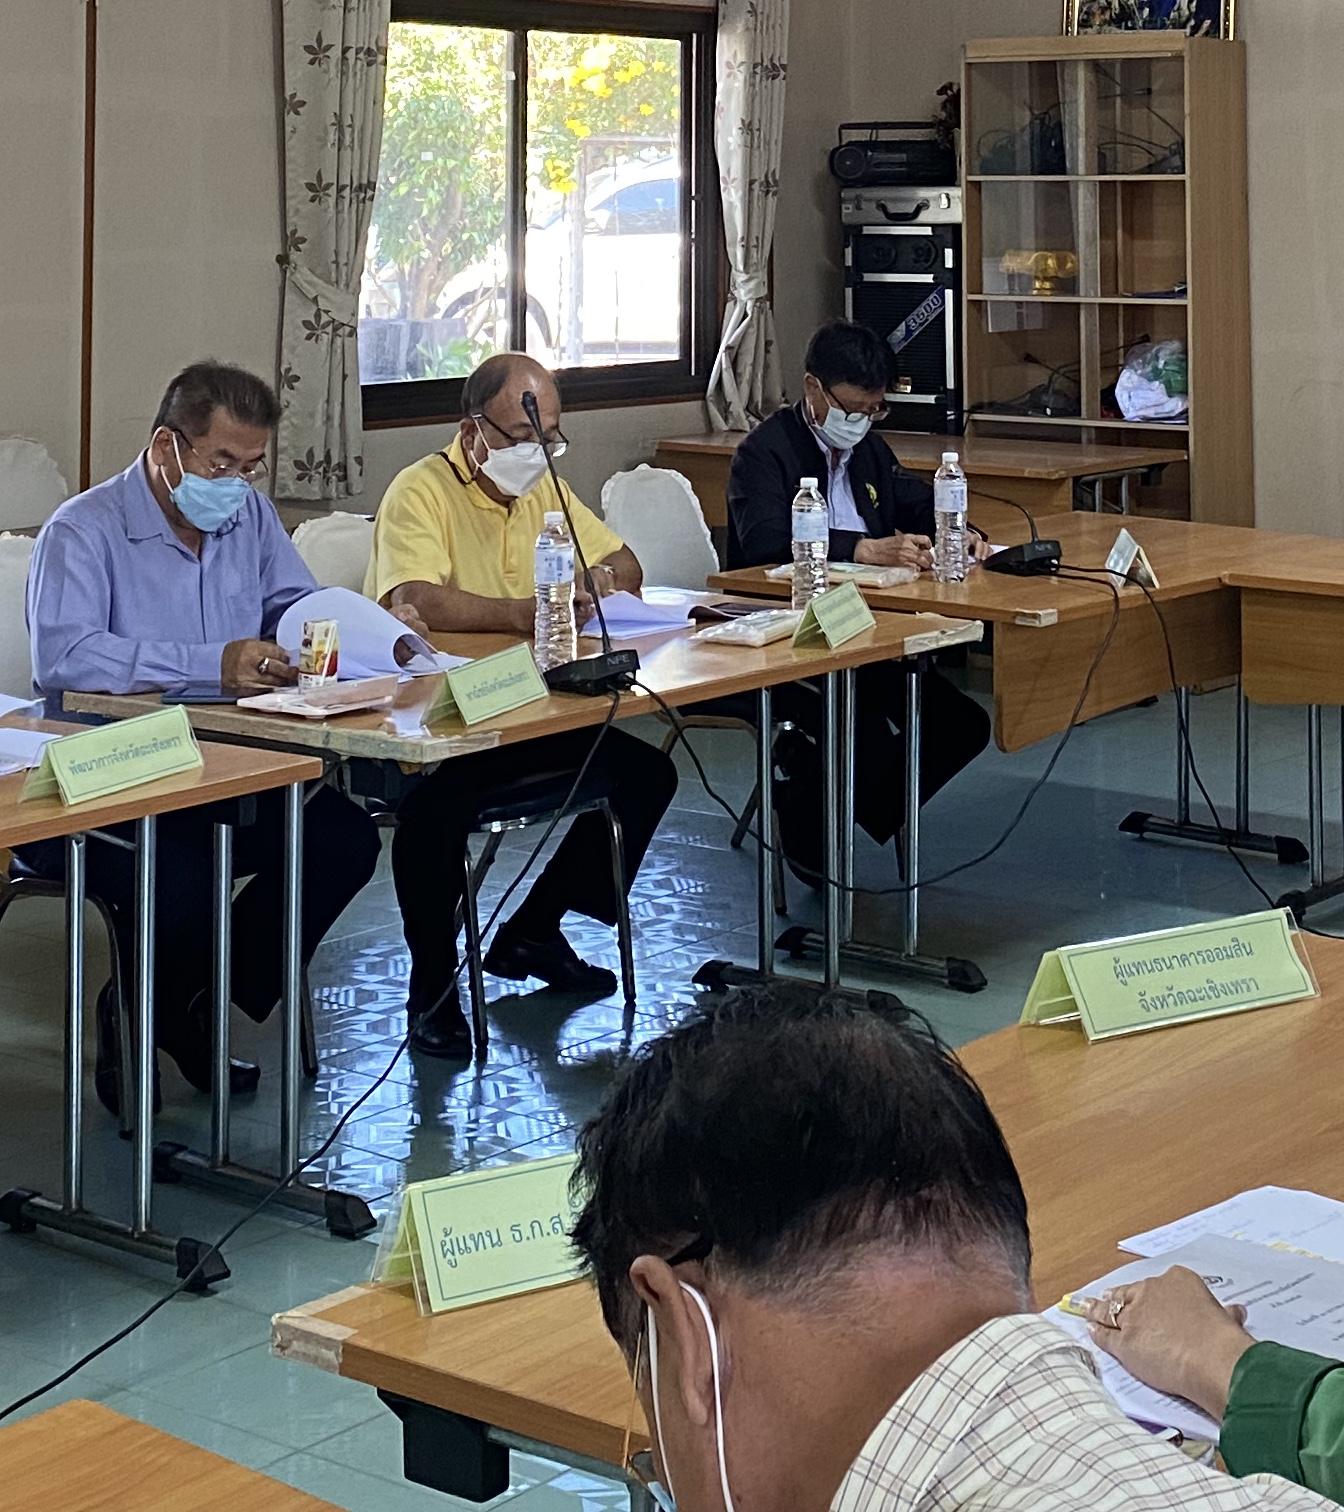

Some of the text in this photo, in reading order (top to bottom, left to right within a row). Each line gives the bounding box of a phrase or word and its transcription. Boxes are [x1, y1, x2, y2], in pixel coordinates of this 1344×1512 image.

[907, 294, 942, 330] 3500
[607, 654, 630, 666] NPE
[1113, 936, 1255, 987] ผู้แทนธนาคารออมสิน
[1138, 975, 1260, 1014] จังหวัดฉะเชิงเทรา
[439, 1226, 503, 1269] ผู้แทน
